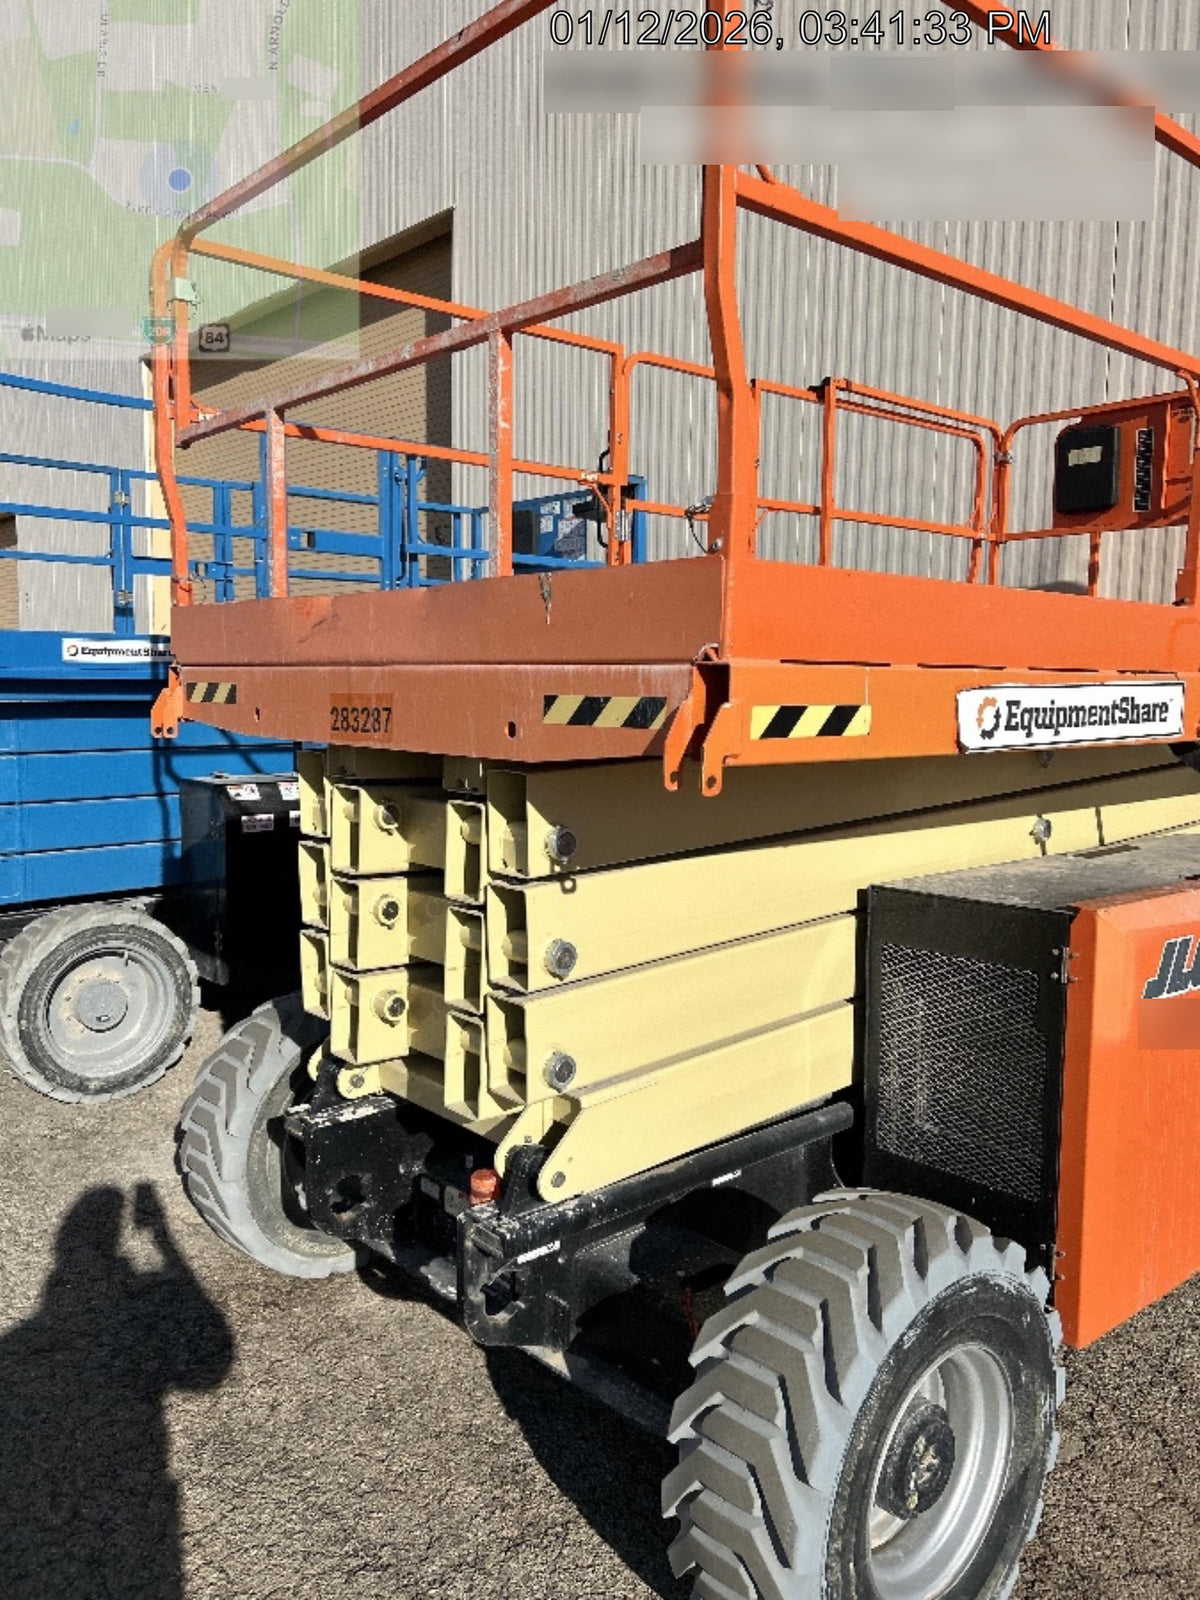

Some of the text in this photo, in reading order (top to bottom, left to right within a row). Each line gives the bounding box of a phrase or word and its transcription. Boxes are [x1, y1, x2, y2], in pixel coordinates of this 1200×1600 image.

[330, 706, 392, 733] 283287
[1003, 696, 1169, 738] EquipmentShare
[1141, 934, 1200, 999] JL
